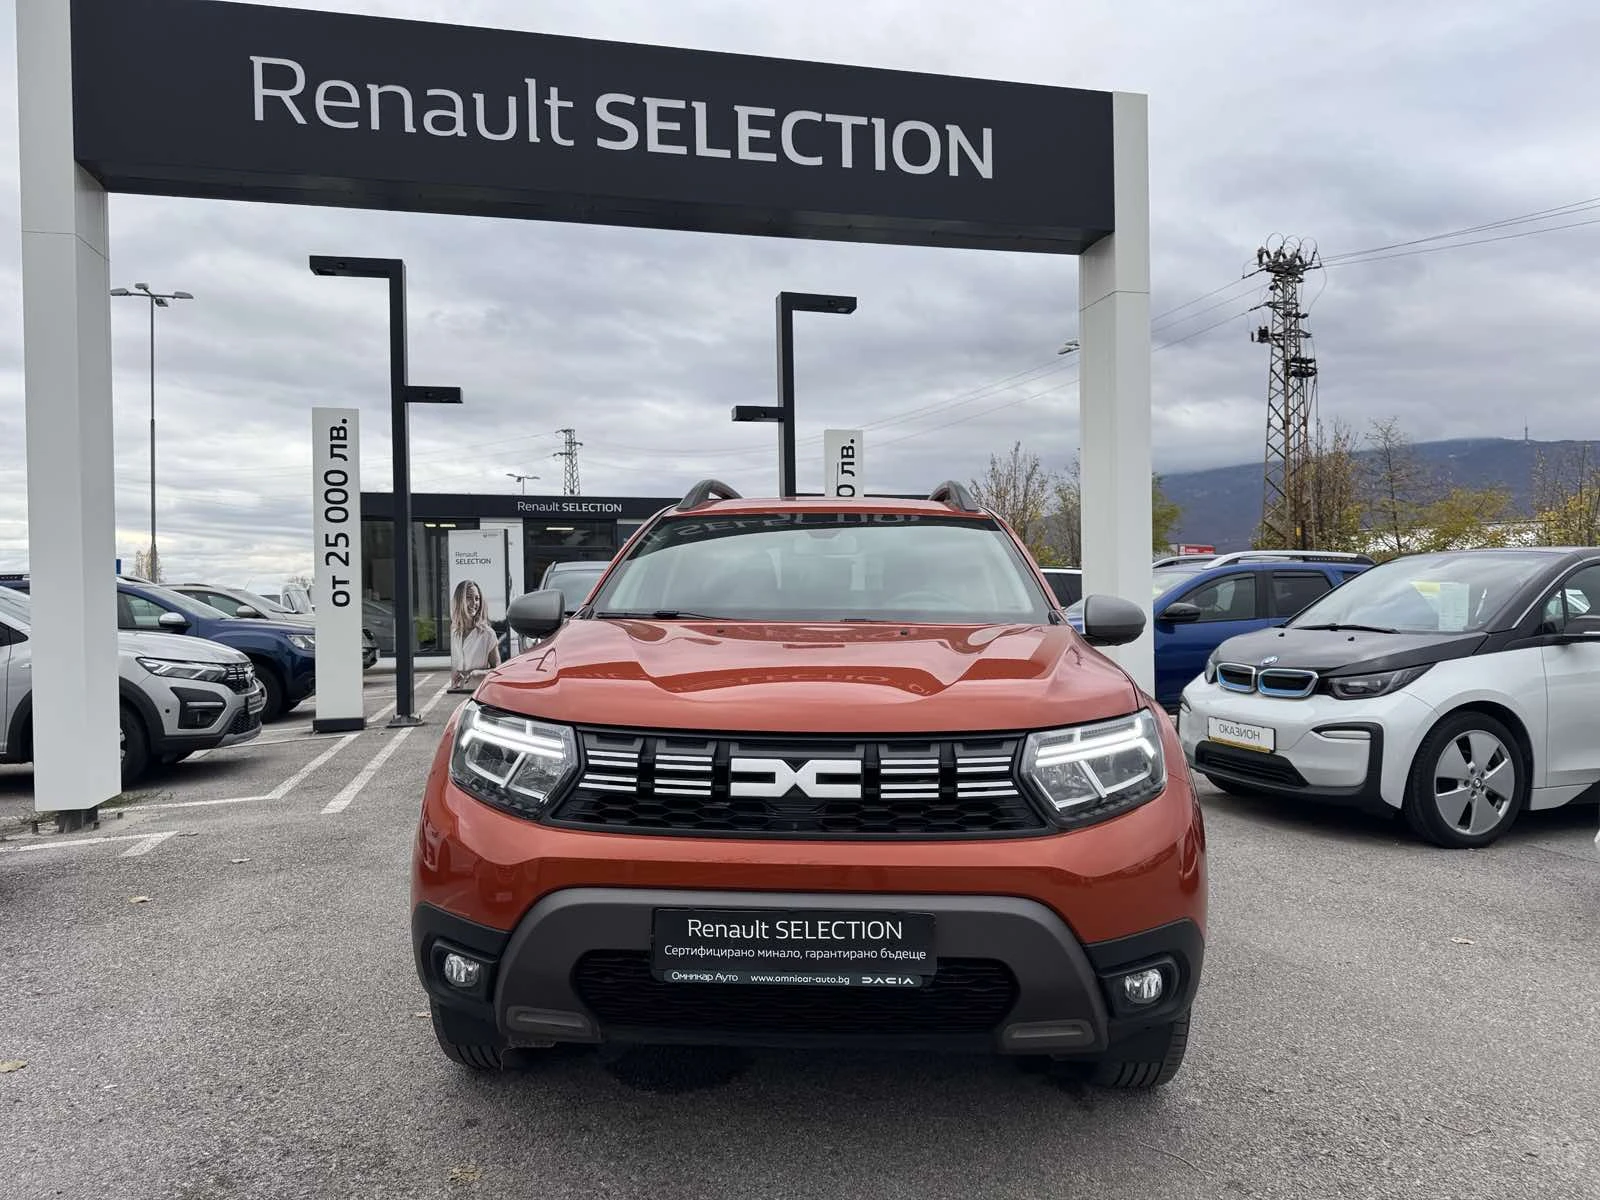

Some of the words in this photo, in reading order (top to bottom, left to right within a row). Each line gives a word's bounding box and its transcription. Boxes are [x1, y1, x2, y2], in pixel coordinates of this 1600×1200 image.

[249, 55, 576, 147] Renault
[595, 92, 994, 180] SELECTION
[329, 417, 349, 462] лв.
[840, 438, 856, 477] лв.
[323, 469, 349, 524] 000
[517, 501, 560, 512] Renault
[561, 502, 623, 513] SELECTION
[324, 532, 350, 567] 25
[331, 574, 350, 608] от
[1219, 724, 1260, 740] ОКАЗИОН
[687, 918, 770, 939] Renault
[775, 920, 903, 940] SELECTION
[664, 944, 755, 959] Сертифицирано
[757, 949, 803, 959] минало,
[805, 949, 878, 960] гарантирано
[880, 947, 927, 961] бъдеще
[671, 971, 714, 982] Омникар
[715, 972, 739, 983] Ауто
[750, 974, 850, 985] www.omnicar-auto.bg
[861, 976, 915, 985] DACIA
